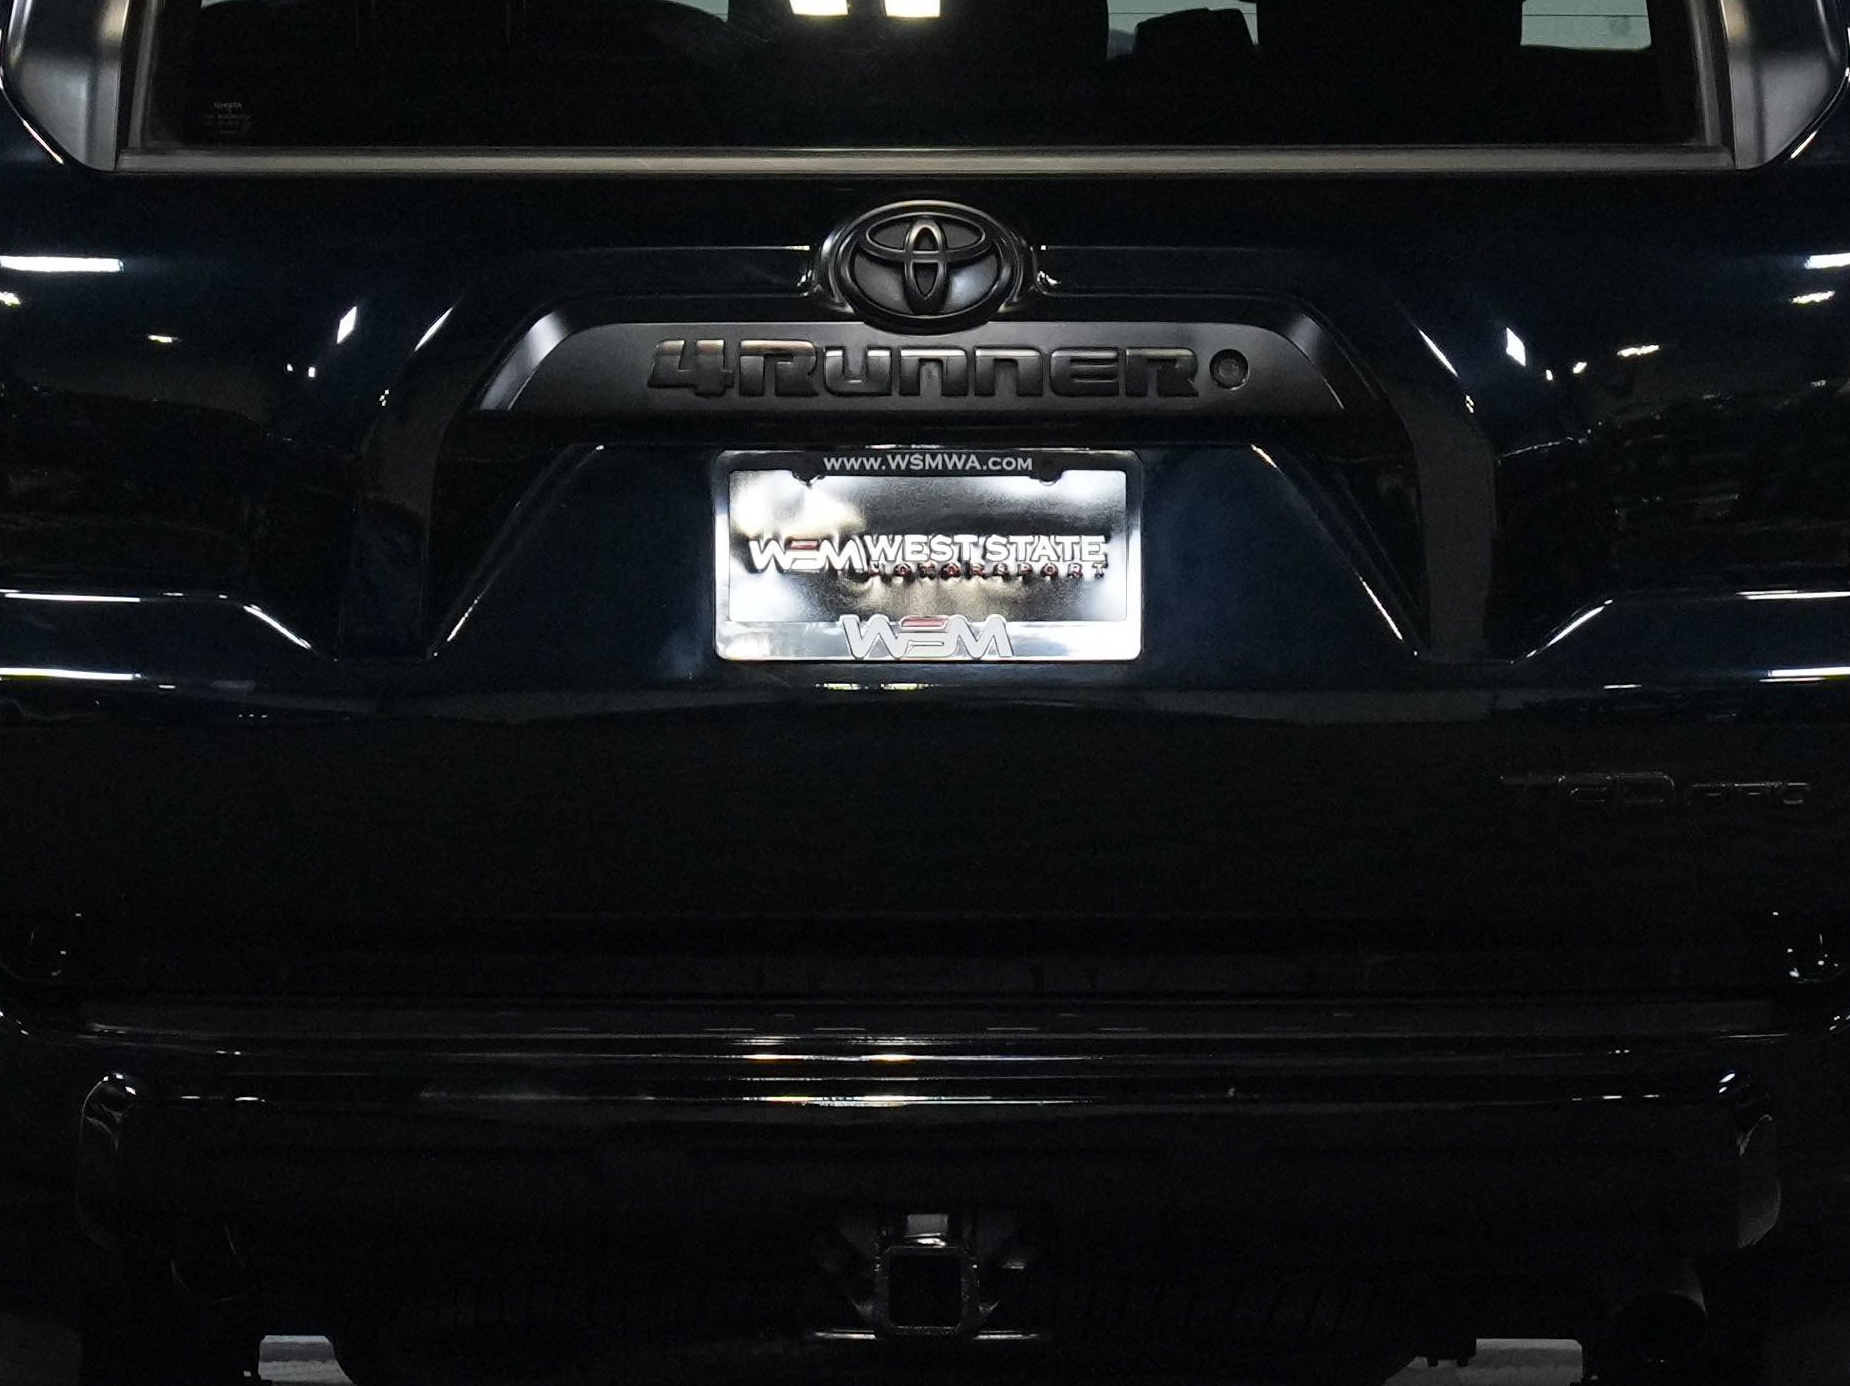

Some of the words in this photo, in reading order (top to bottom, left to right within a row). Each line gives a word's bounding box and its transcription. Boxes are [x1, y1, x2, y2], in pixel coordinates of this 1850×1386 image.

[823, 454, 1033, 472] WWW.WSMWA.COM
[865, 534, 974, 562] WEST
[983, 534, 1106, 562] STATE
[868, 562, 1107, 578] MOTORSPORT
